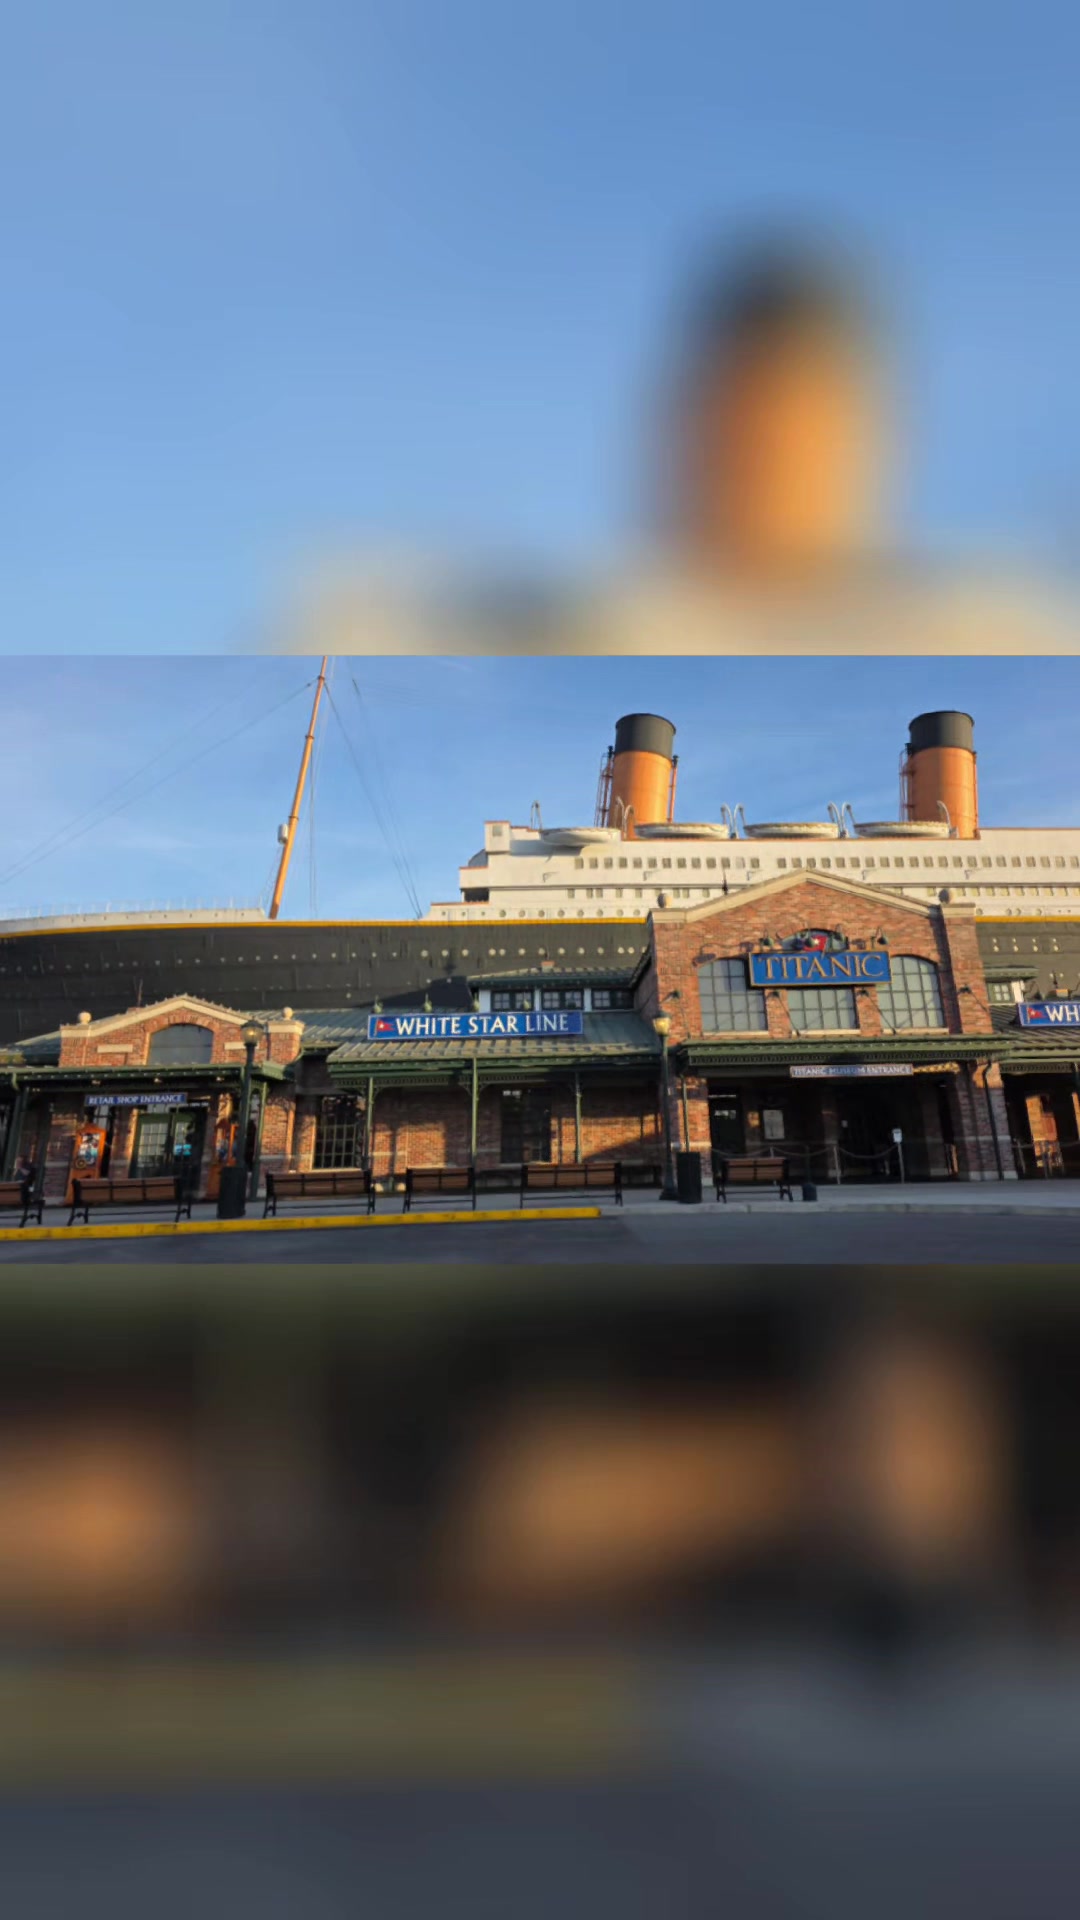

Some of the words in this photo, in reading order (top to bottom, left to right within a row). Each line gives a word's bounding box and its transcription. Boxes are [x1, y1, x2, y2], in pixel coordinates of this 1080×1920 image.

[758, 954, 884, 980] TITANIC
[396, 1016, 461, 1035] WHITE
[468, 1015, 519, 1034] STAR
[525, 1013, 569, 1033] LINE
[794, 1067, 827, 1076] TITANIC
[867, 1065, 911, 1074] ENTRANCE
[88, 1096, 114, 1105] RETAIL
[116, 1095, 139, 1104] SHOP
[140, 1094, 183, 1103] ENTRANCE
